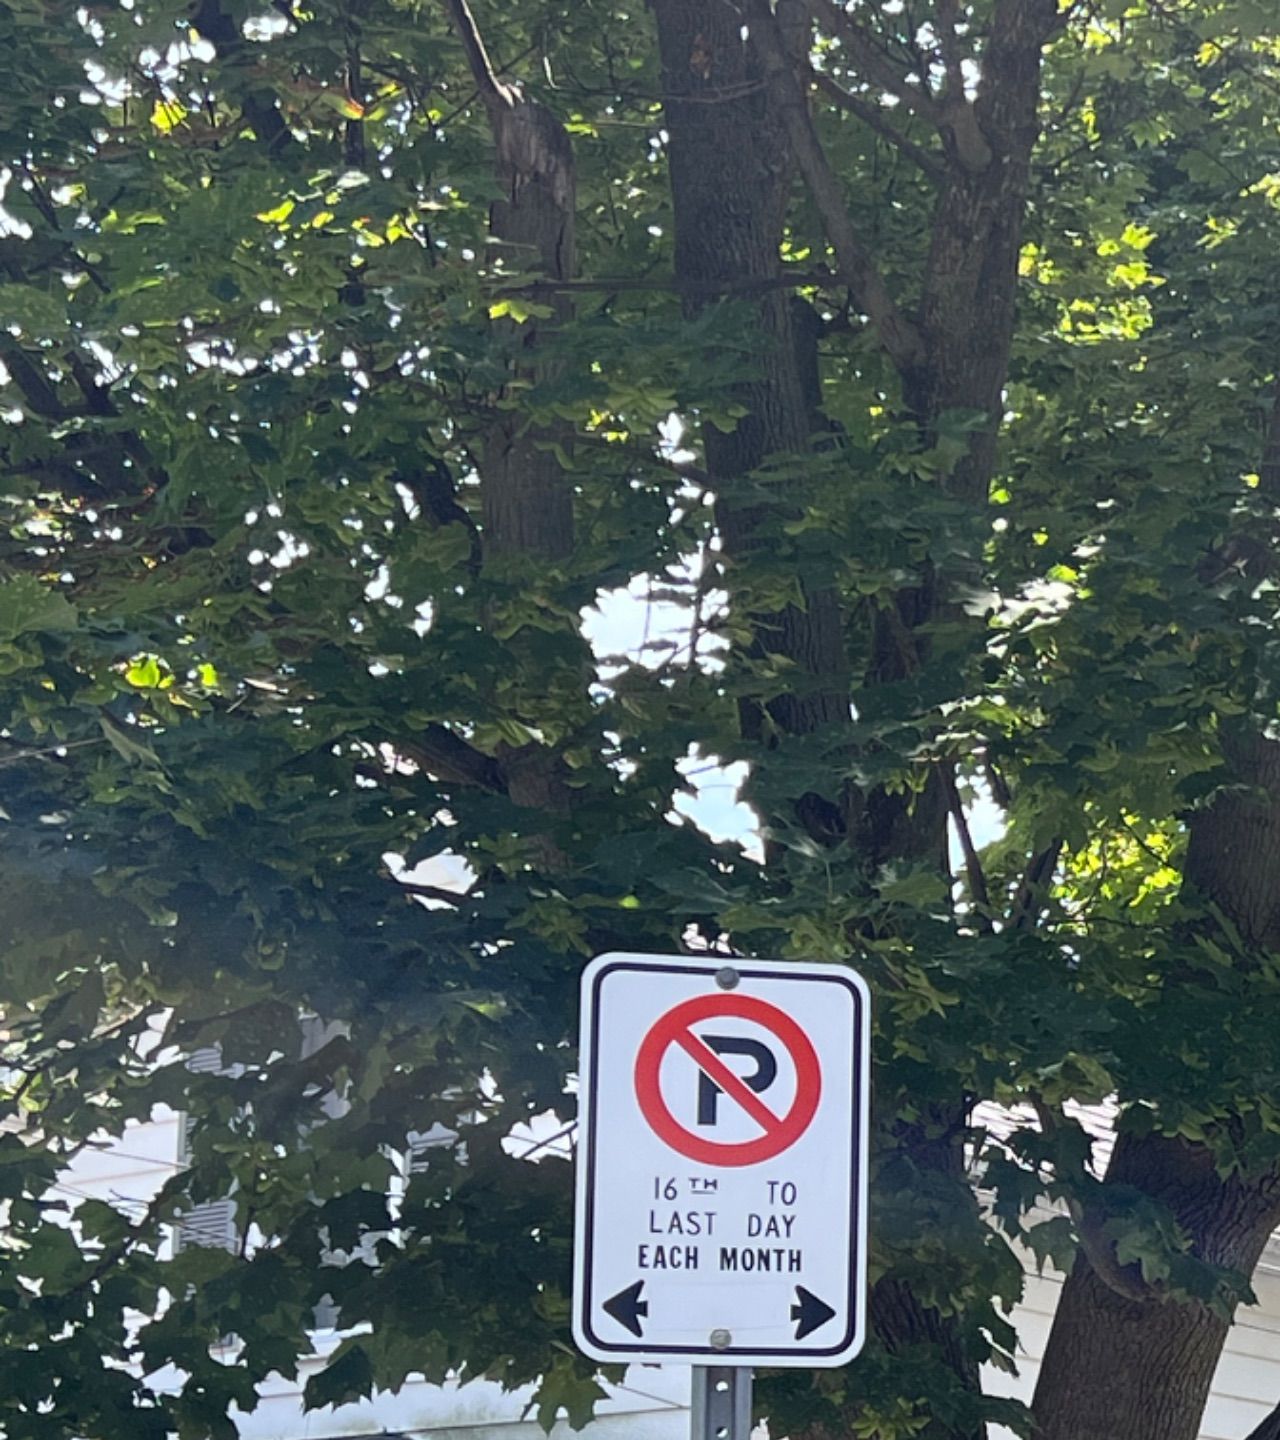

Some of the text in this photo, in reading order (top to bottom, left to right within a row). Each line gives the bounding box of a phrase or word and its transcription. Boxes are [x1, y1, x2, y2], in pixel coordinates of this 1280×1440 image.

[766, 1180, 798, 1206] TO
[650, 1209, 796, 1238] LAST DAY
[638, 1244, 802, 1272] EACH MONTH
